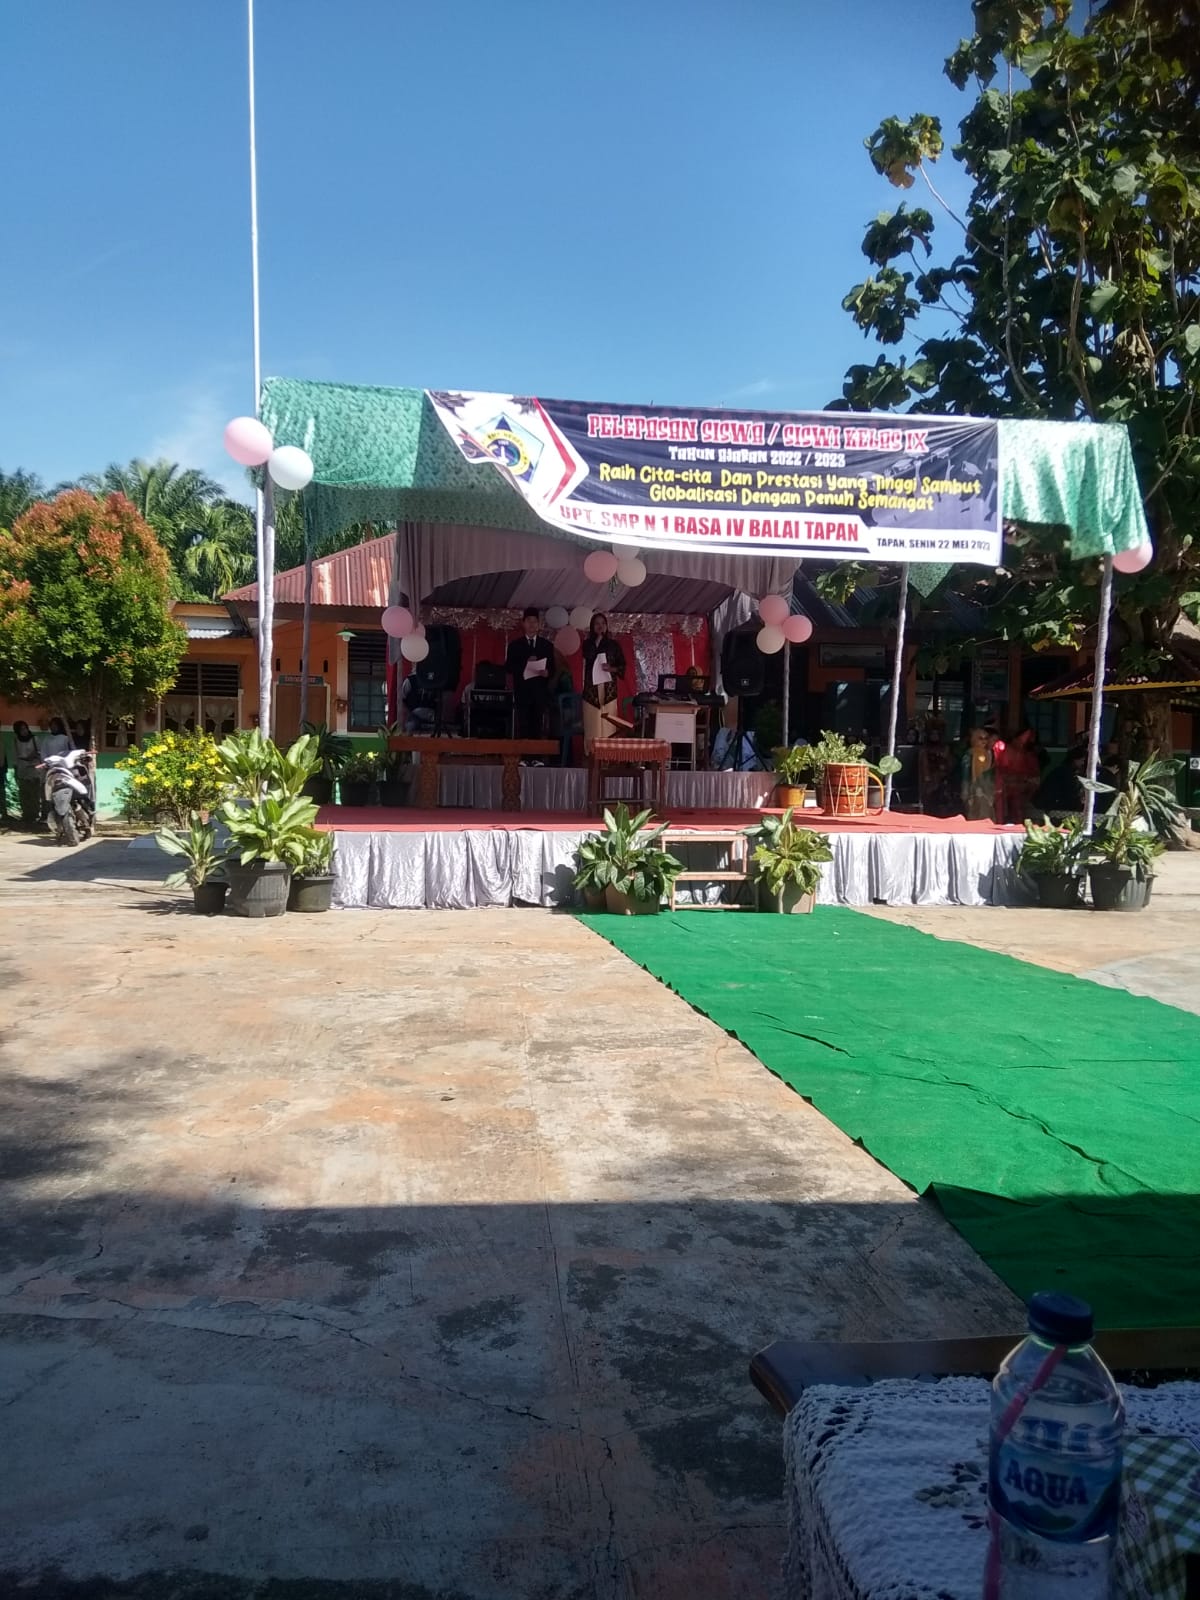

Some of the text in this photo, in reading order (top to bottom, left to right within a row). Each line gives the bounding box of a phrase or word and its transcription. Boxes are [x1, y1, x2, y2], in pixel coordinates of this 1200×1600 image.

[588, 415, 929, 452] PELEPASAN SISWA / SISWI KELAS IX
[668, 446, 846, 467] TAHUN AJARAN 2022 / 2023
[600, 463, 980, 495] Raih Cita-cita Dan Prestasi Yang Tinggi Sambut
[650, 484, 934, 512] Globalisasi Dengan Penuh Semangat
[560, 505, 858, 541] UPT. SMP N 1 BASA IV BALAI TAPAN
[909, 539, 935, 548] SENIN
[938, 540, 949, 549] 22
[952, 540, 968, 549] MEI
[1005, 1459, 1088, 1508] AQUA
